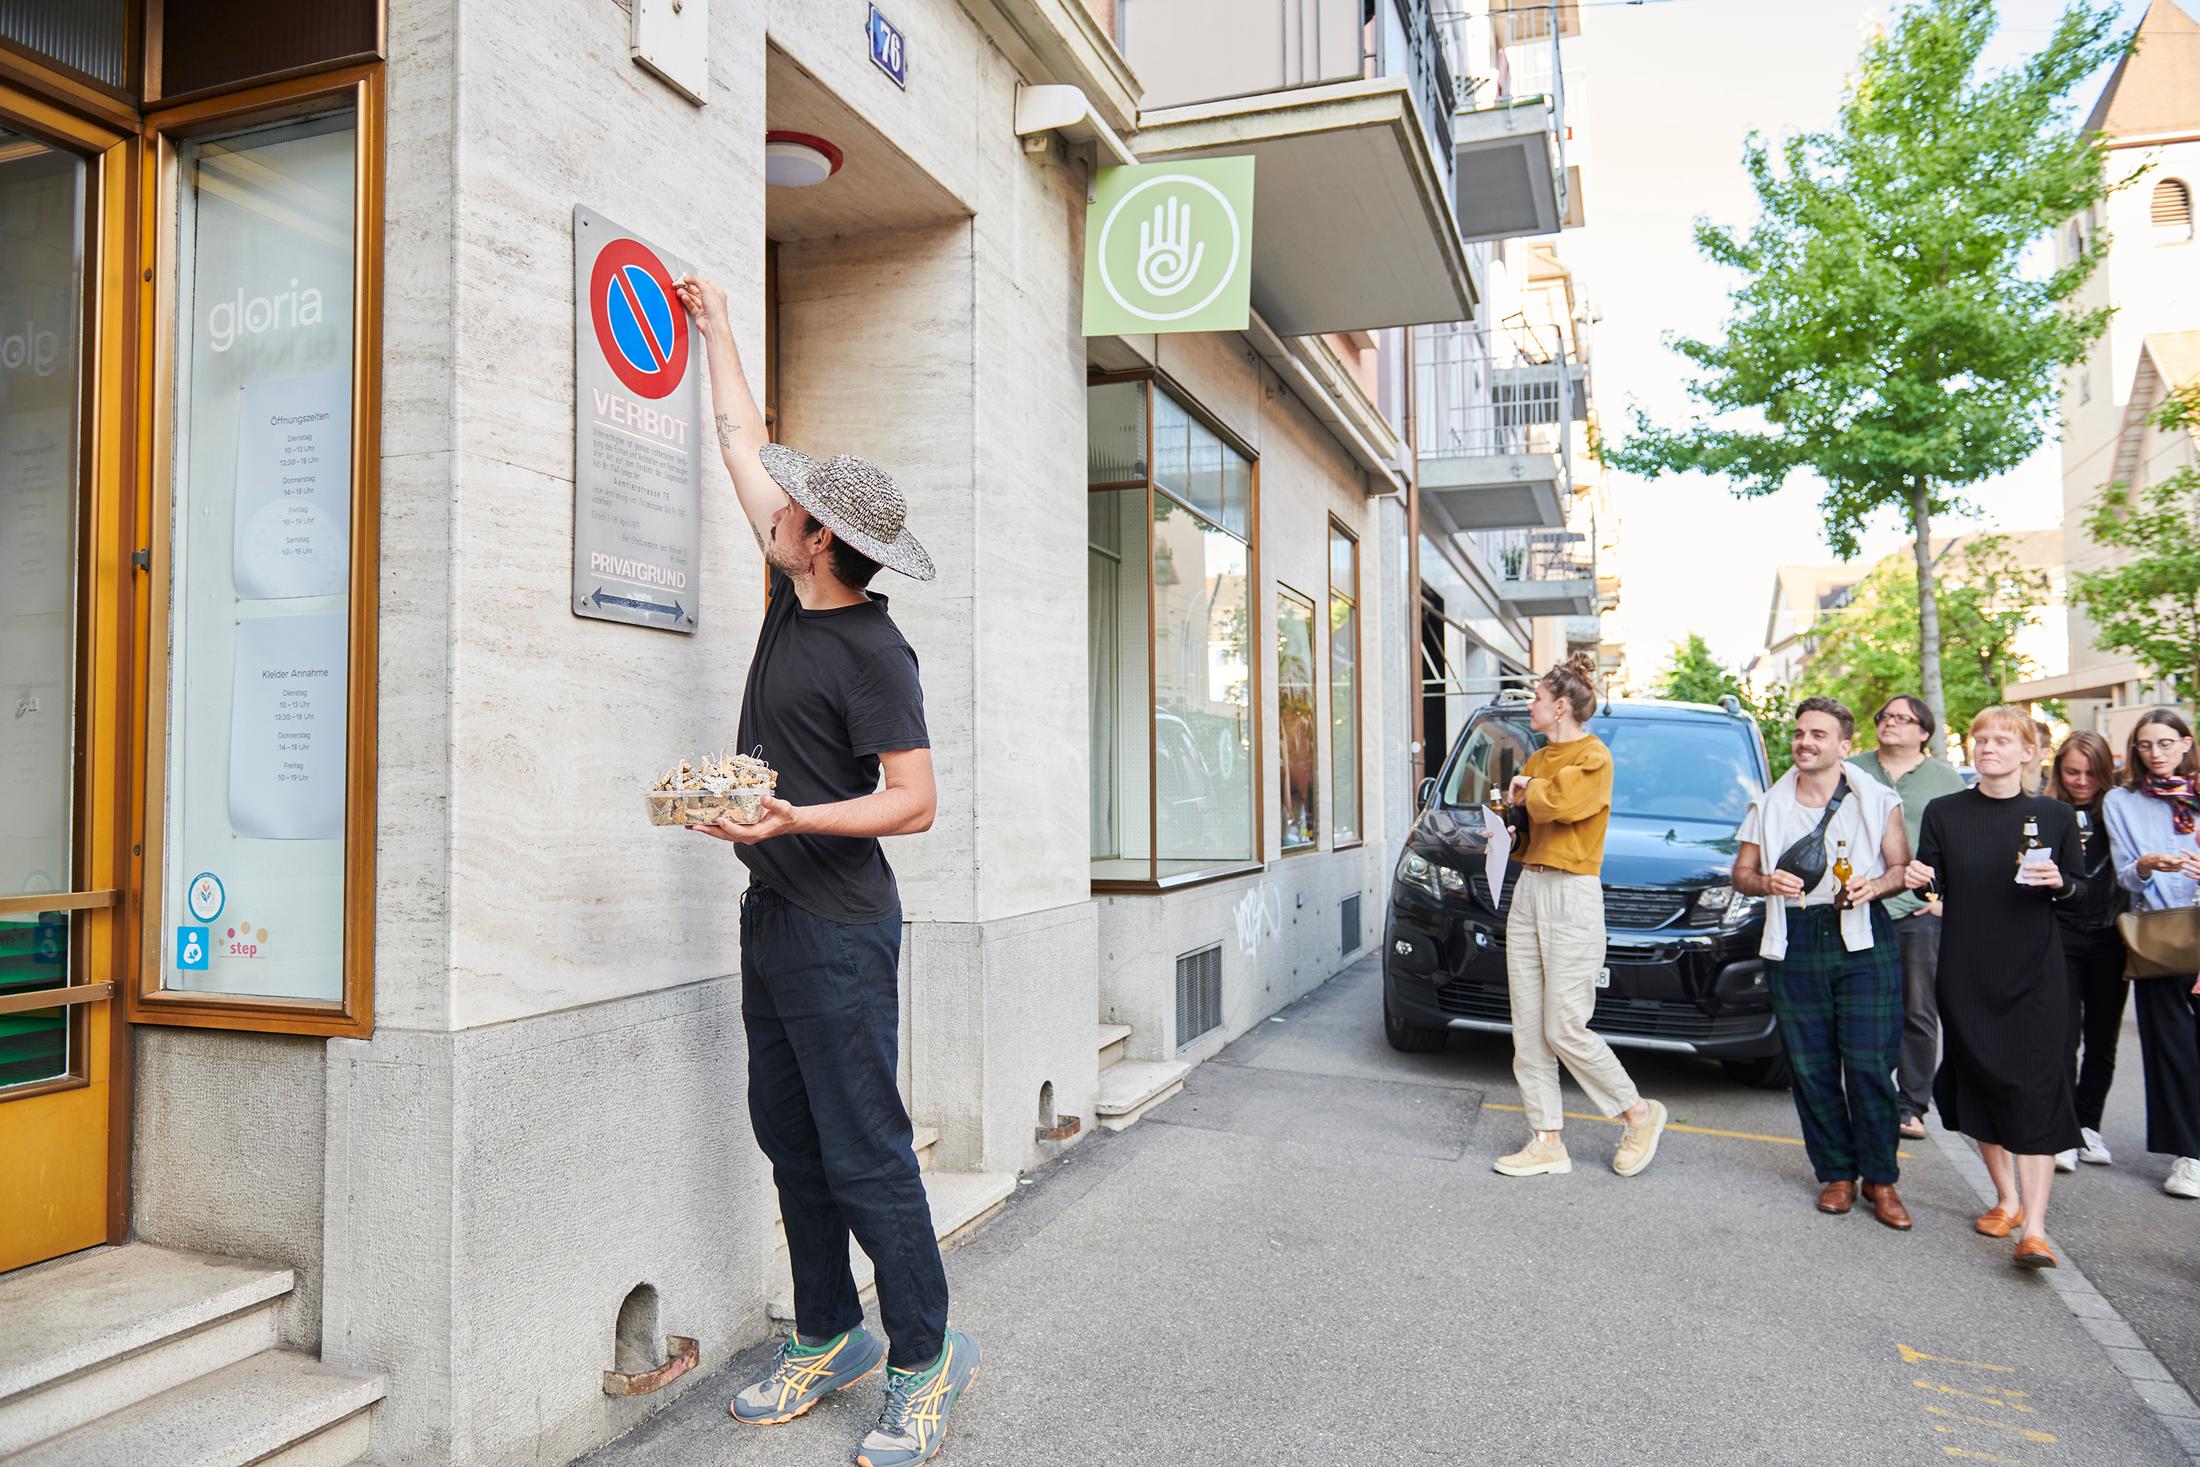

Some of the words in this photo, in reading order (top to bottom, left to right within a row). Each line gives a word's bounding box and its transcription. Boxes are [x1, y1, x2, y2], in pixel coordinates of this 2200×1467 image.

[880, 20, 900, 73] 76
[208, 277, 322, 353] gloria
[271, 412, 329, 425] Öffnungszeiten
[592, 387, 689, 445] VERBOT
[287, 434, 313, 442] Dienstag
[282, 476, 316, 484] Donnerstag
[591, 552, 686, 588] PRIVATGRUND
[262, 670, 289, 679] Kleider
[291, 669, 329, 678] Annahme
[282, 689, 308, 698] Dienstag
[277, 731, 311, 740] Donnerstag
[284, 762, 304, 771] Freitag
[230, 941, 257, 959] step
